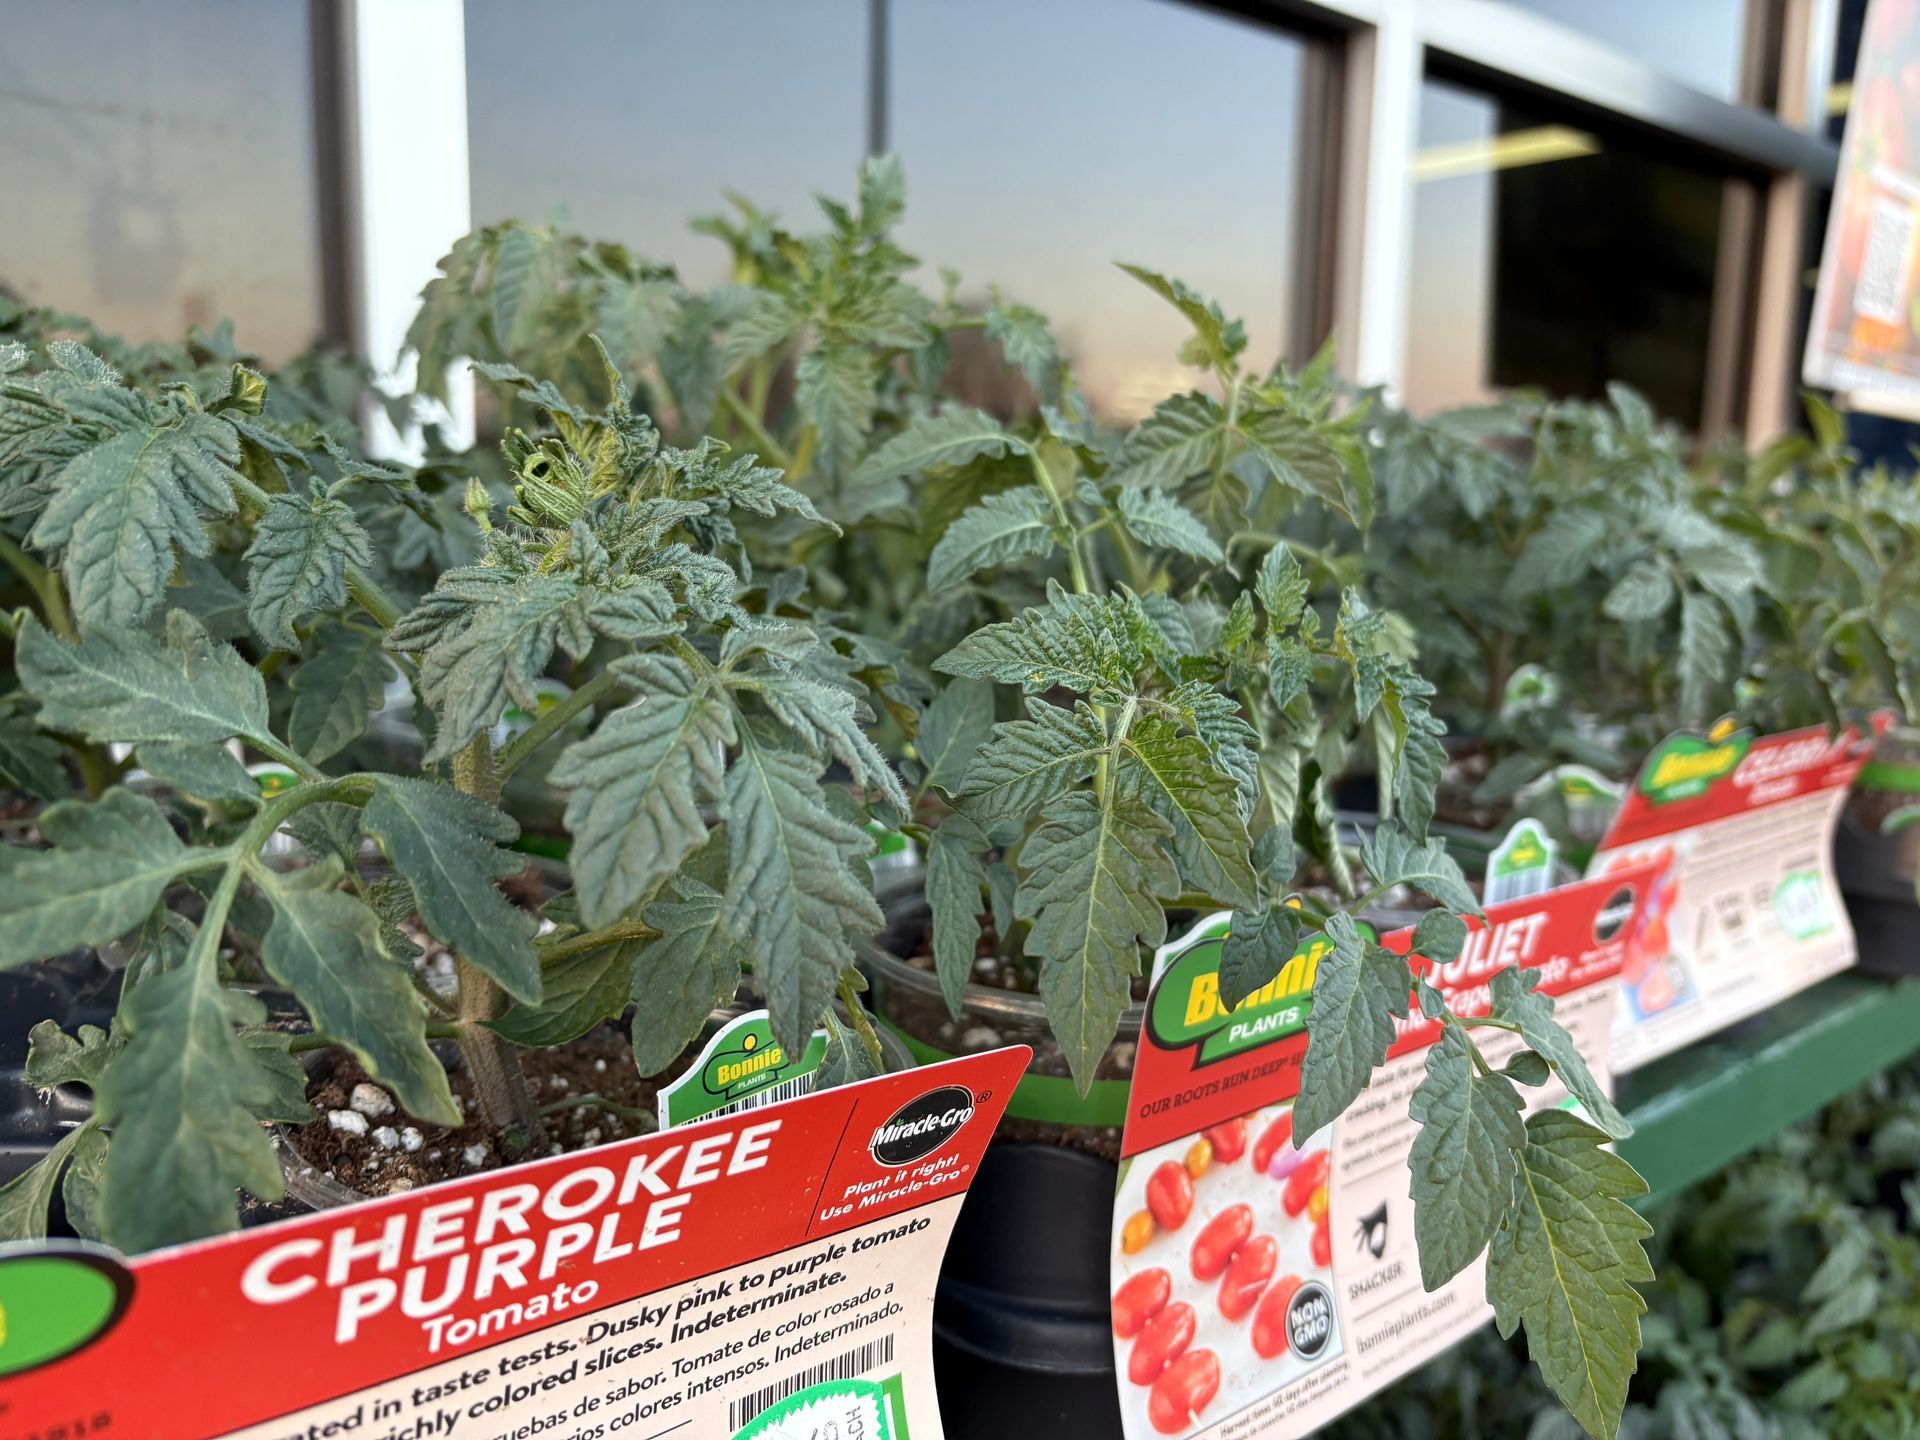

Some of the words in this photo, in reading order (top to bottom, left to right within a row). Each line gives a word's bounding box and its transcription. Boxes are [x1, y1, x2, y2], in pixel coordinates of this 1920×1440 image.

[1228, 1006, 1300, 1043] PLANTS
[717, 1047, 783, 1086] Bonnie
[737, 1072, 767, 1090] PLANTS
[1139, 1096, 1170, 1119] OUR
[1173, 1080, 1220, 1108] ROOTS
[1222, 1070, 1249, 1091] RUN
[871, 1105, 974, 1149] Miracle-Gro
[843, 1175, 891, 1200] Plant
[894, 1169, 908, 1184] it
[911, 1153, 960, 1179] right!
[241, 1118, 783, 1306] CHEROKEE
[820, 1203, 853, 1221] Use
[334, 1192, 692, 1345] PURPLE
[373, 1398, 402, 1422] in
[412, 1368, 491, 1407] taste
[498, 1338, 578, 1377] tests.
[586, 1304, 673, 1346] Dusky
[674, 1276, 735, 1320] pink
[739, 1272, 765, 1292] to
[768, 1243, 847, 1287] purple
[851, 1217, 931, 1254] tomato
[422, 1278, 600, 1353] Tomato
[1291, 1294, 1328, 1329] NON
[1294, 1314, 1330, 1346] GMO
[381, 1408, 462, 1440] ichly
[468, 1359, 579, 1419] colored
[584, 1336, 664, 1376] slices.
[670, 1270, 847, 1344] Indeterminate.
[573, 1395, 601, 1418] de
[605, 1370, 667, 1406] sabor.
[672, 1341, 743, 1378] Tomate
[747, 1327, 771, 1348] de
[775, 1308, 821, 1338] color
[823, 1281, 881, 1319] rosado
[884, 1281, 894, 1294] a
[609, 1390, 683, 1433] colores
[687, 1356, 769, 1401] intensos.
[775, 1299, 904, 1364] Indeterminado.
